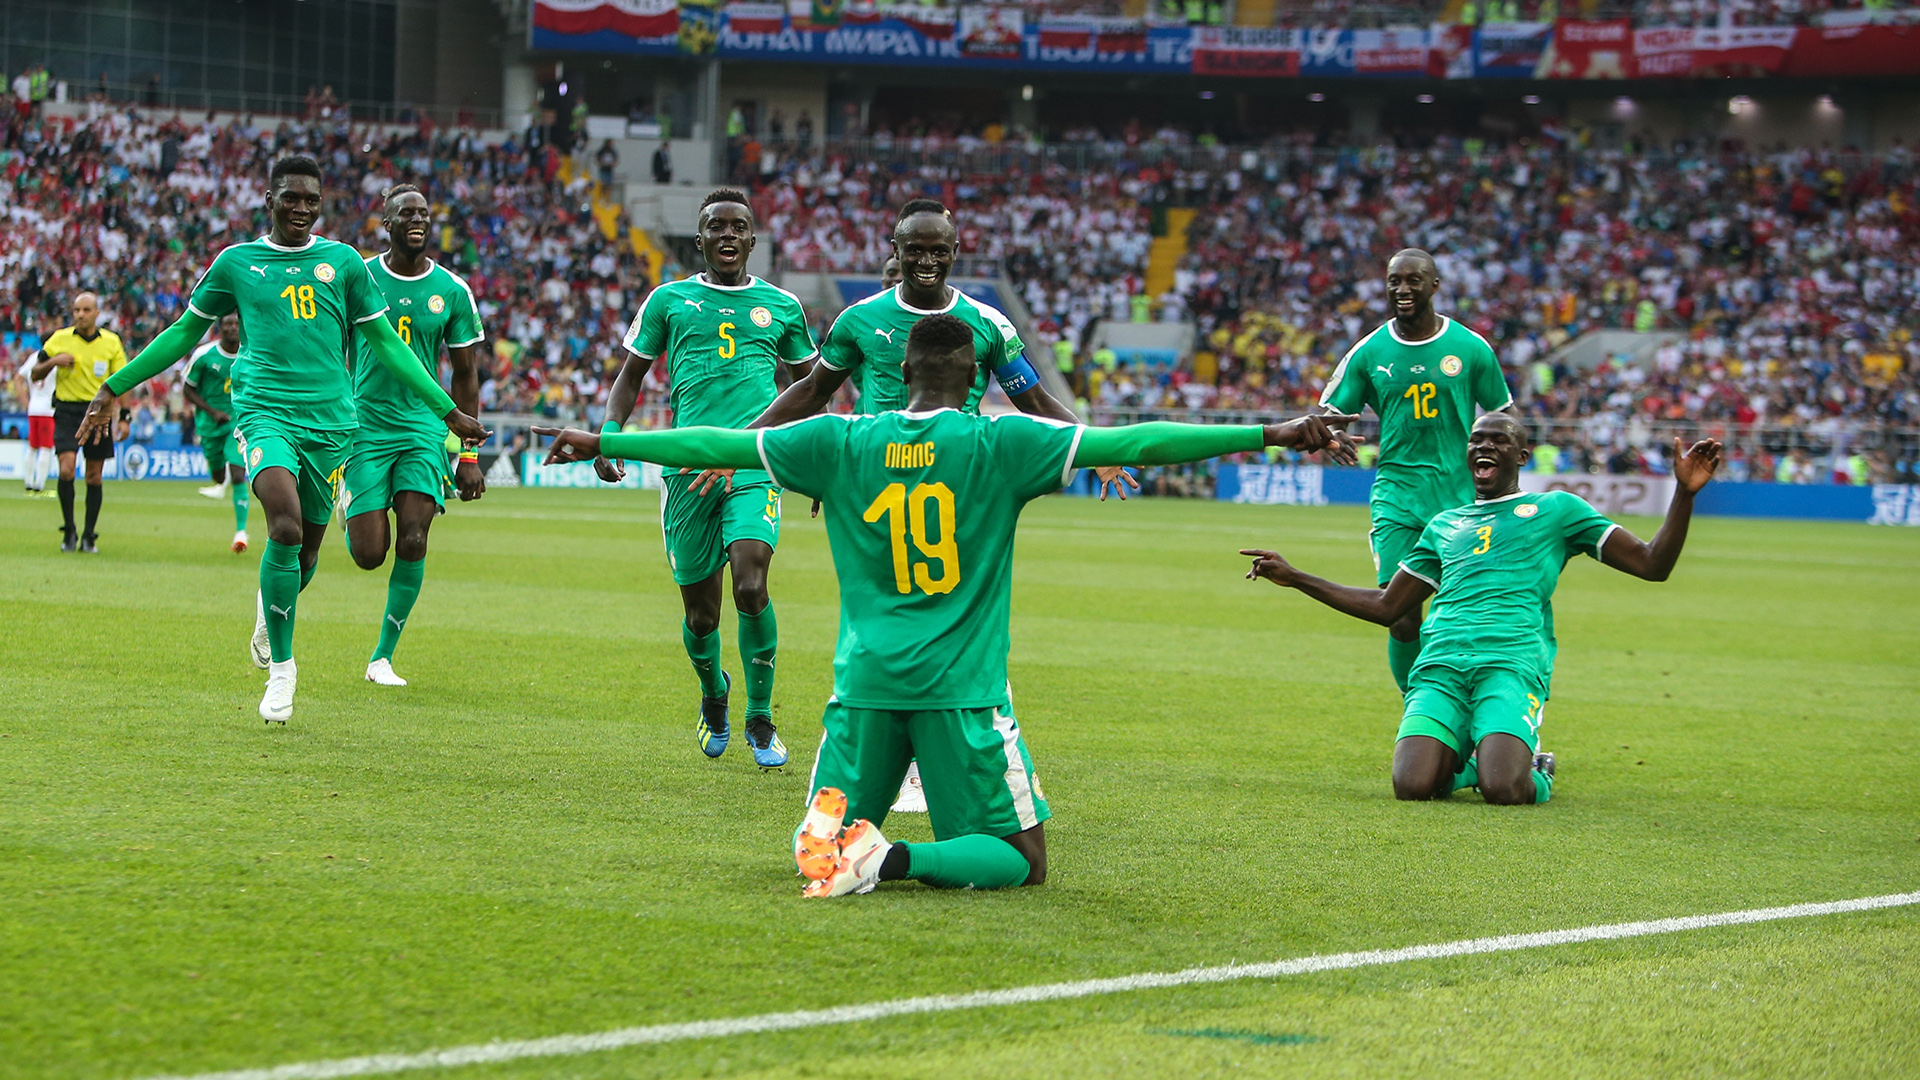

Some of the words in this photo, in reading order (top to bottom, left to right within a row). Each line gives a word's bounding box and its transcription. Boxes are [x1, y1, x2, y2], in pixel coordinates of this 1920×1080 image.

[280, 284, 317, 320] 18
[397, 315, 412, 345] 6
[718, 322, 736, 359] 5
[1404, 382, 1439, 419] 12
[885, 441, 935, 468] NIANG
[863, 481, 961, 596] 19
[1473, 525, 1493, 556] 3
